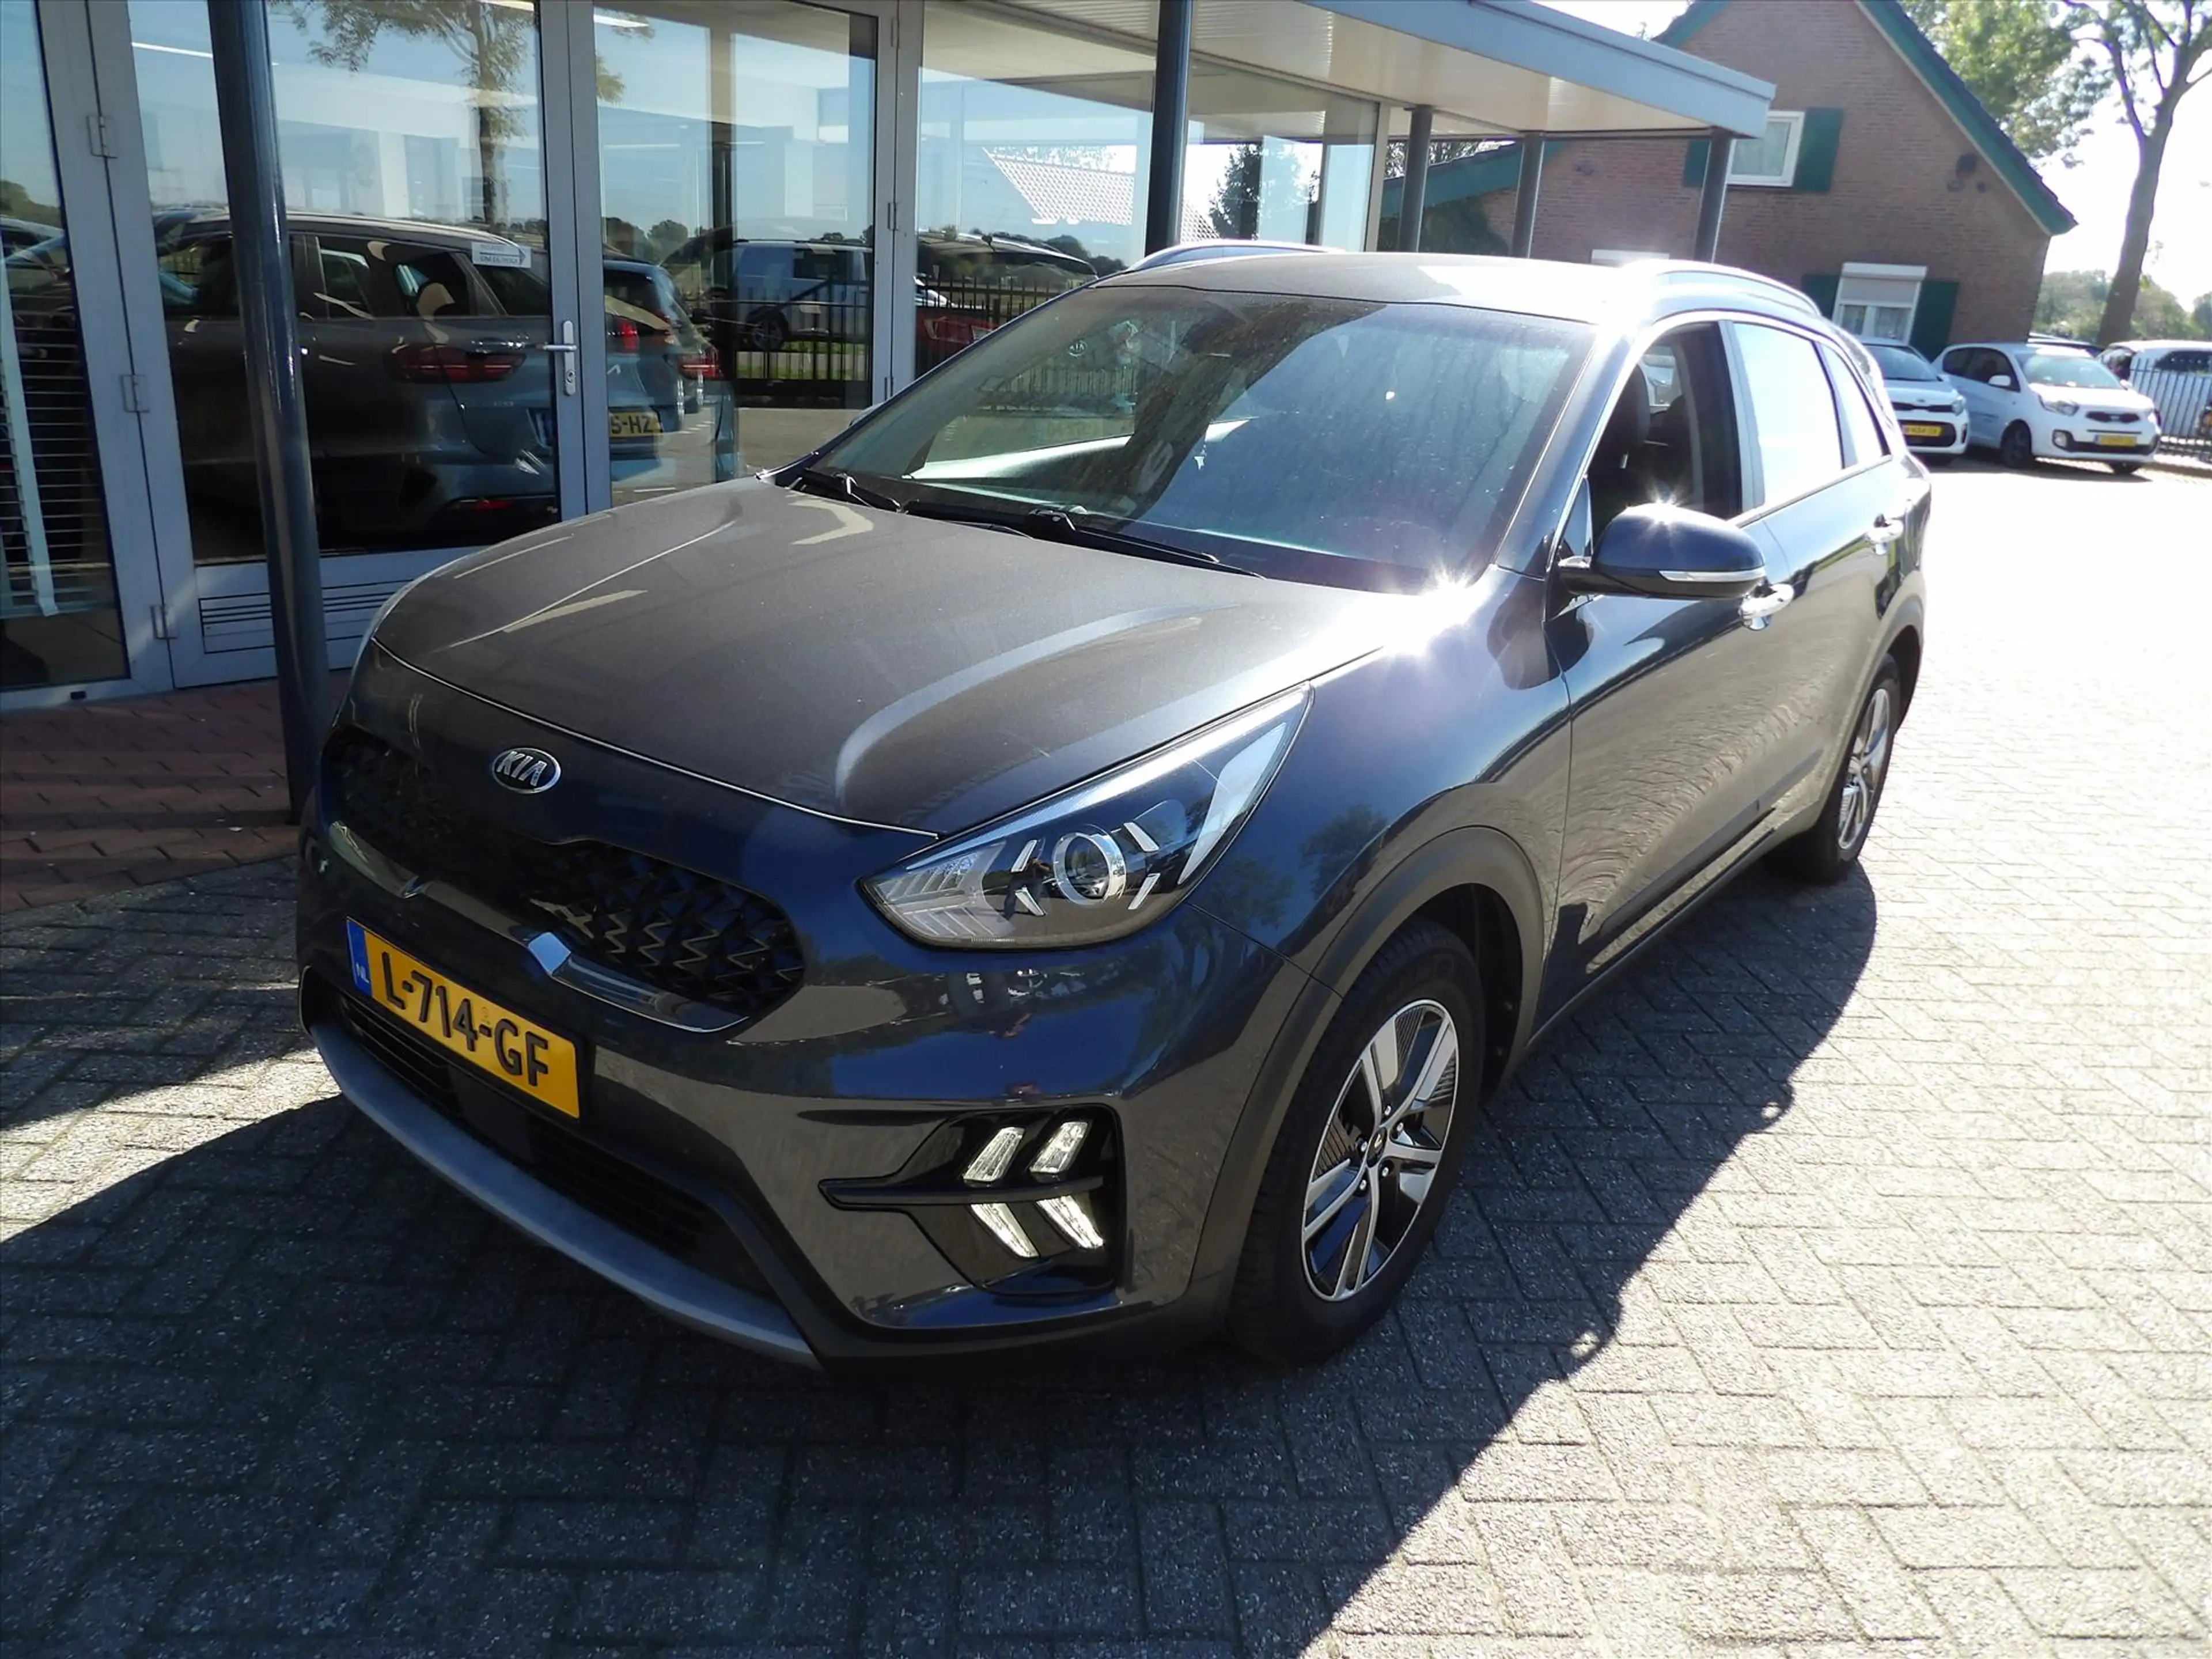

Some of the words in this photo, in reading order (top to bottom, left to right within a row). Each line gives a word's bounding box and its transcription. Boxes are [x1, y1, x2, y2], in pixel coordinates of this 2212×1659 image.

[496, 751, 548, 787] KIA
[355, 961, 370, 984] NL
[381, 950, 549, 1088] L-714-GF
